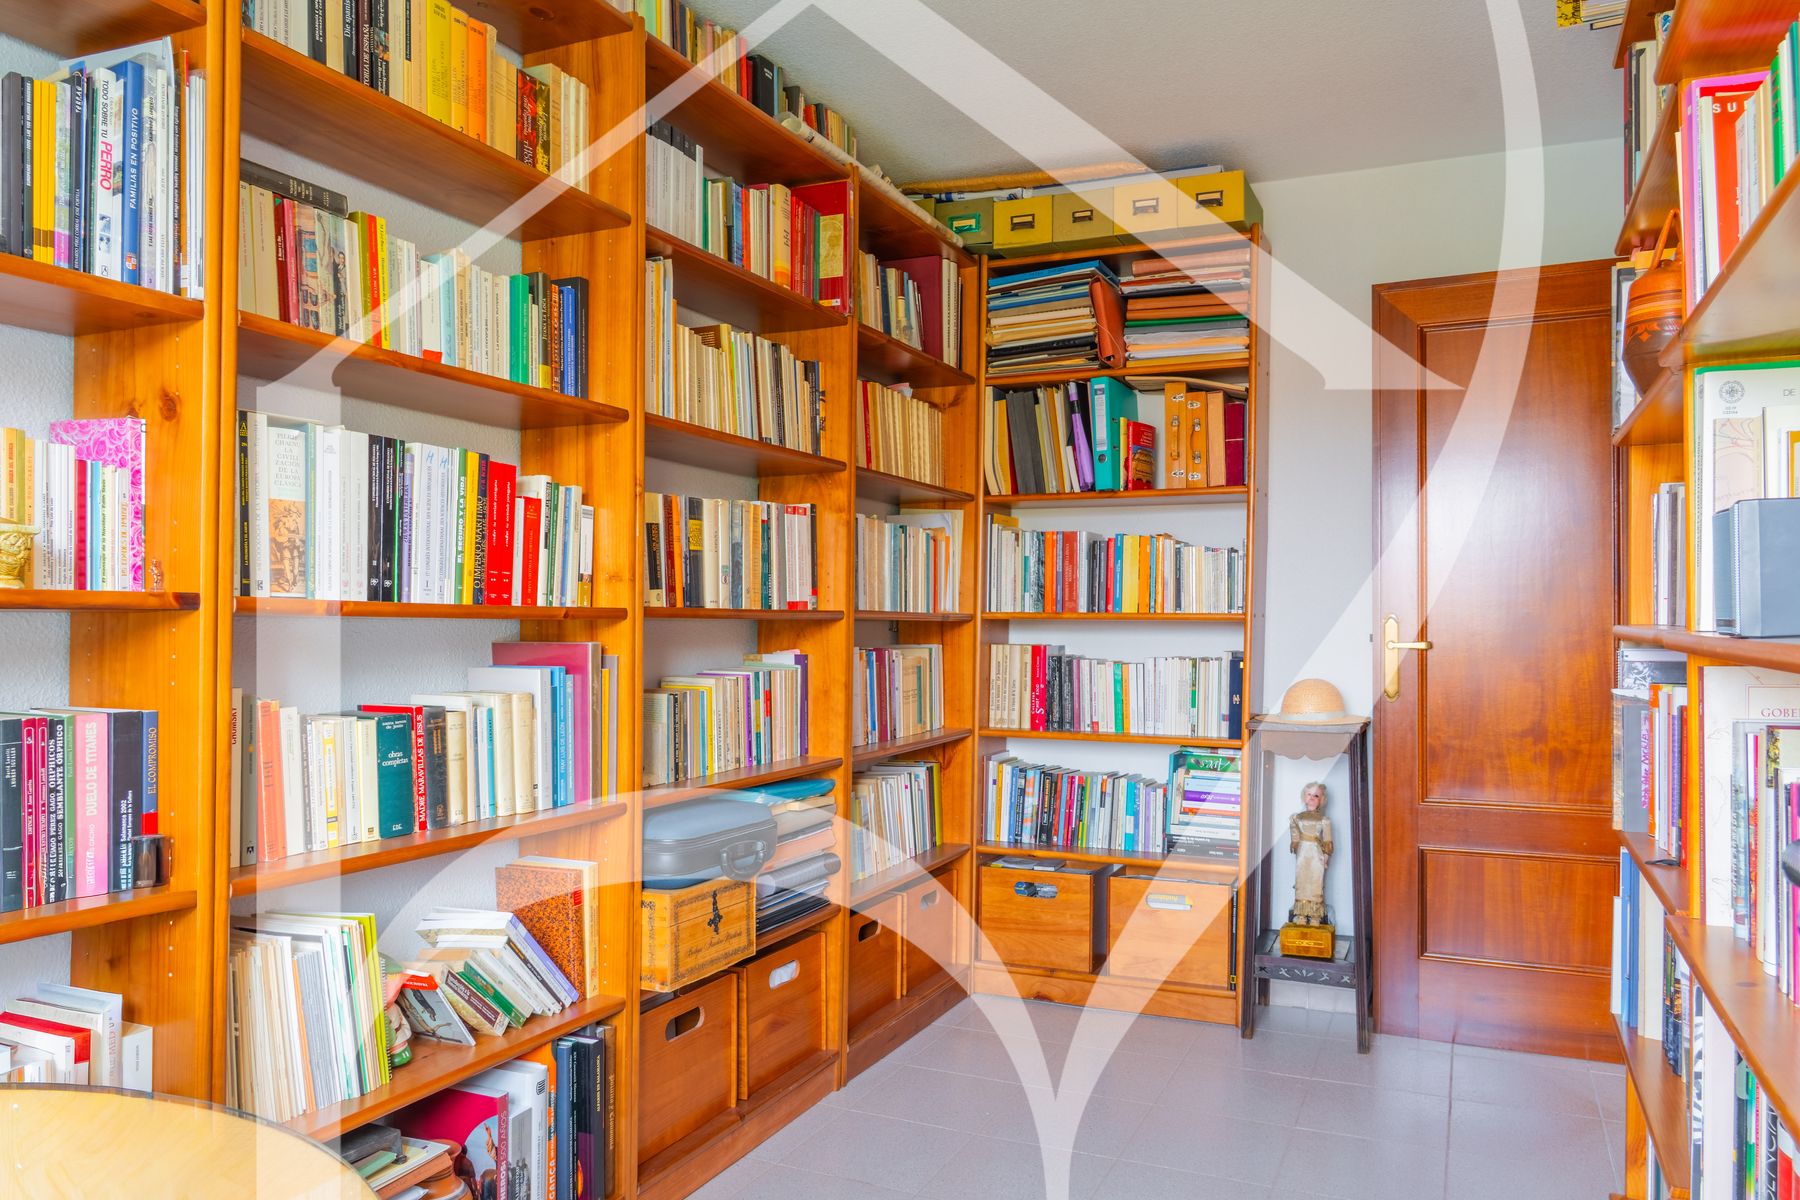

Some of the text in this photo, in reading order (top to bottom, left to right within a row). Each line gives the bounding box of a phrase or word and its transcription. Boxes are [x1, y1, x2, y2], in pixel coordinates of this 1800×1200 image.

[344, 0, 352, 24] spanis
[363, 54, 369, 64] DE
[101, 128, 108, 138] TU
[100, 140, 113, 190] PERRO
[131, 153, 137, 164] EN
[1783, 388, 1798, 397] DE
[458, 554, 462, 563] EL
[460, 498, 464, 508] LA
[474, 580, 480, 588] O
[1761, 707, 1800, 718] GOBE
[55, 724, 63, 764] ÓRPHICO
[417, 736, 423, 746] DE
[48, 739, 56, 788] ÓRPHICOS
[85, 722, 97, 816] DUELO DE TITANES
[148, 728, 157, 794] EL COMPROMISO
[382, 758, 409, 767] completas
[417, 749, 425, 793] MARAVILLAS
